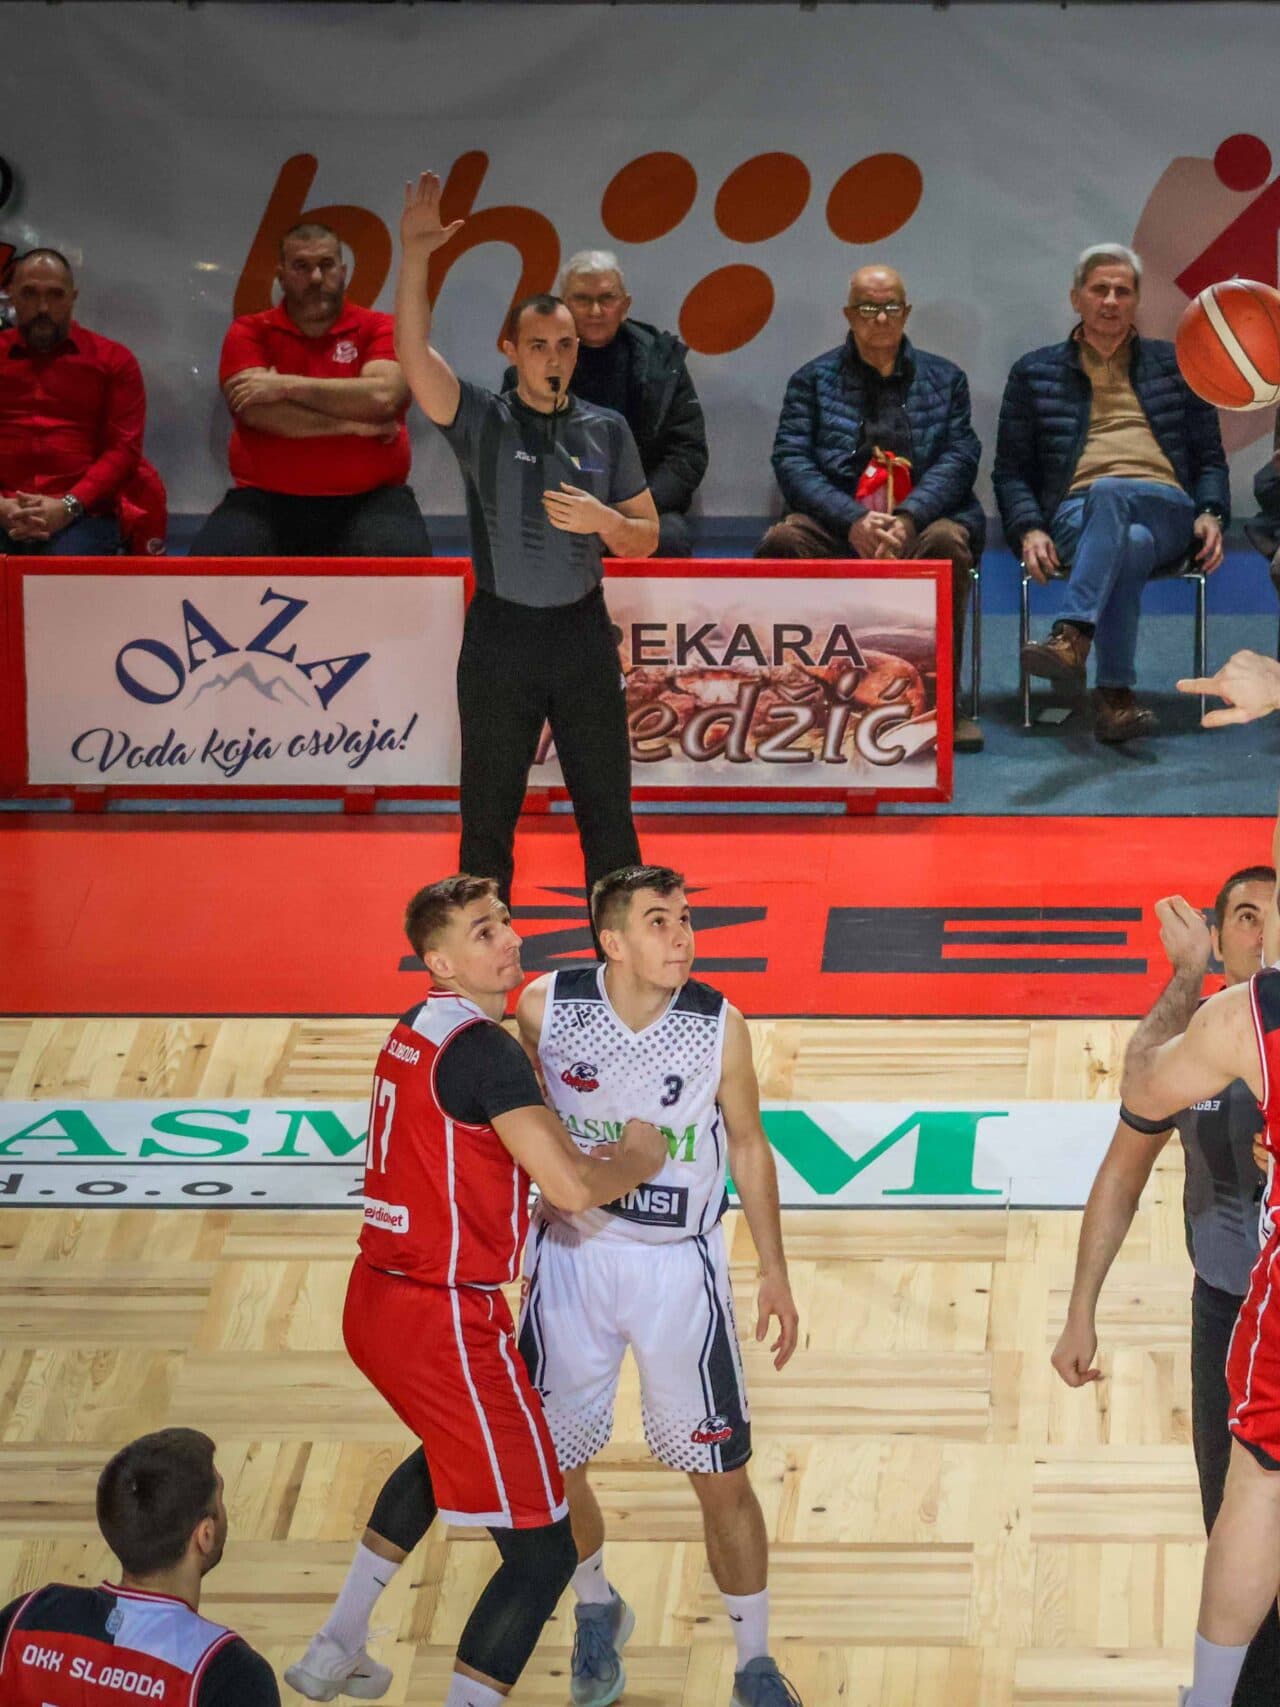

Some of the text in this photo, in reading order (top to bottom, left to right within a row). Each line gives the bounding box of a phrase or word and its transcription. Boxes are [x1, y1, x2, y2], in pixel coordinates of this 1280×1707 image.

[115, 587, 371, 711] OAZA
[630, 623, 866, 667] EKARA
[630, 669, 914, 766] edžić
[71, 713, 419, 778] Voda koja osvaja!
[660, 1074, 684, 1107] 3
[366, 1075, 397, 1174] 17
[566, 1114, 624, 1141] ASM
[615, 1190, 680, 1216] NSI
[22, 1645, 166, 1699] OKK SLOBODA
